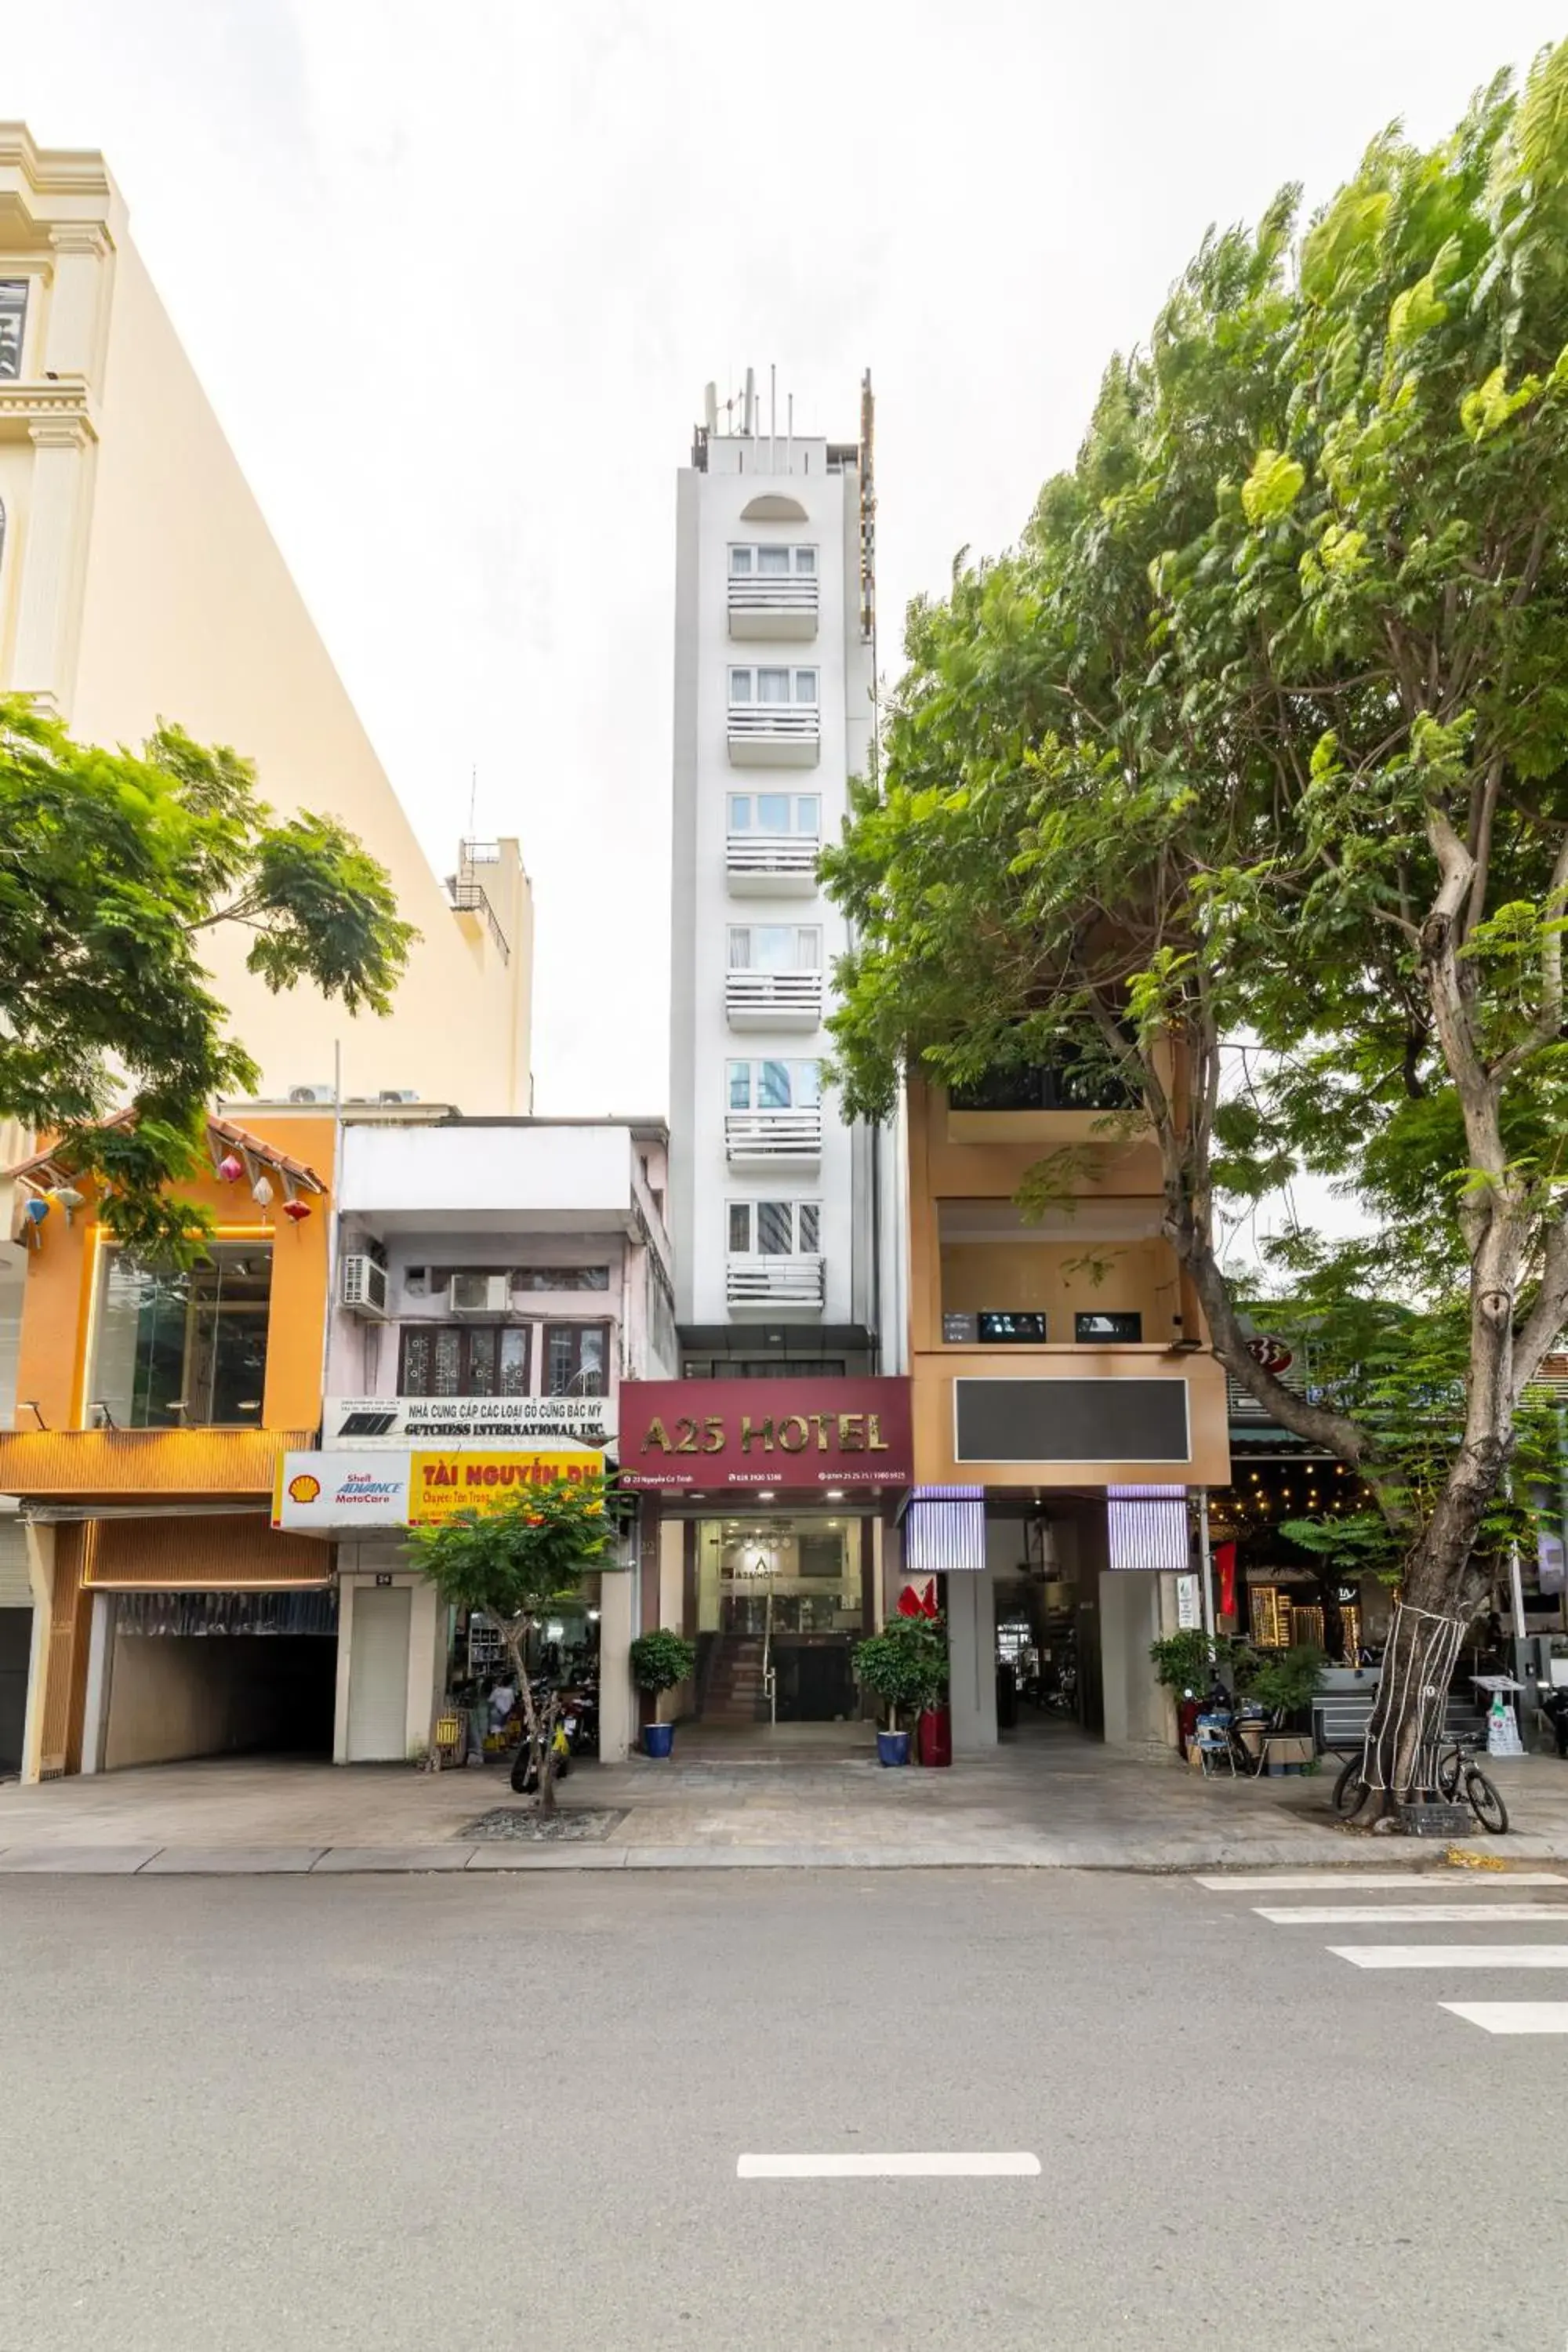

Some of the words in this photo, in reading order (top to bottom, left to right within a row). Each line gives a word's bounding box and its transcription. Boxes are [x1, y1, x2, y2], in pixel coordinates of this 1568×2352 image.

[431, 1404, 456, 1417] CUNG
[473, 1424, 577, 1436] INTERNATIONAL
[581, 1424, 604, 1436] INC.
[641, 1416, 726, 1454] A25
[741, 1414, 889, 1453] HOTEL
[423, 1459, 458, 1486] TÀI
[337, 1482, 404, 1493] ADVANCE
